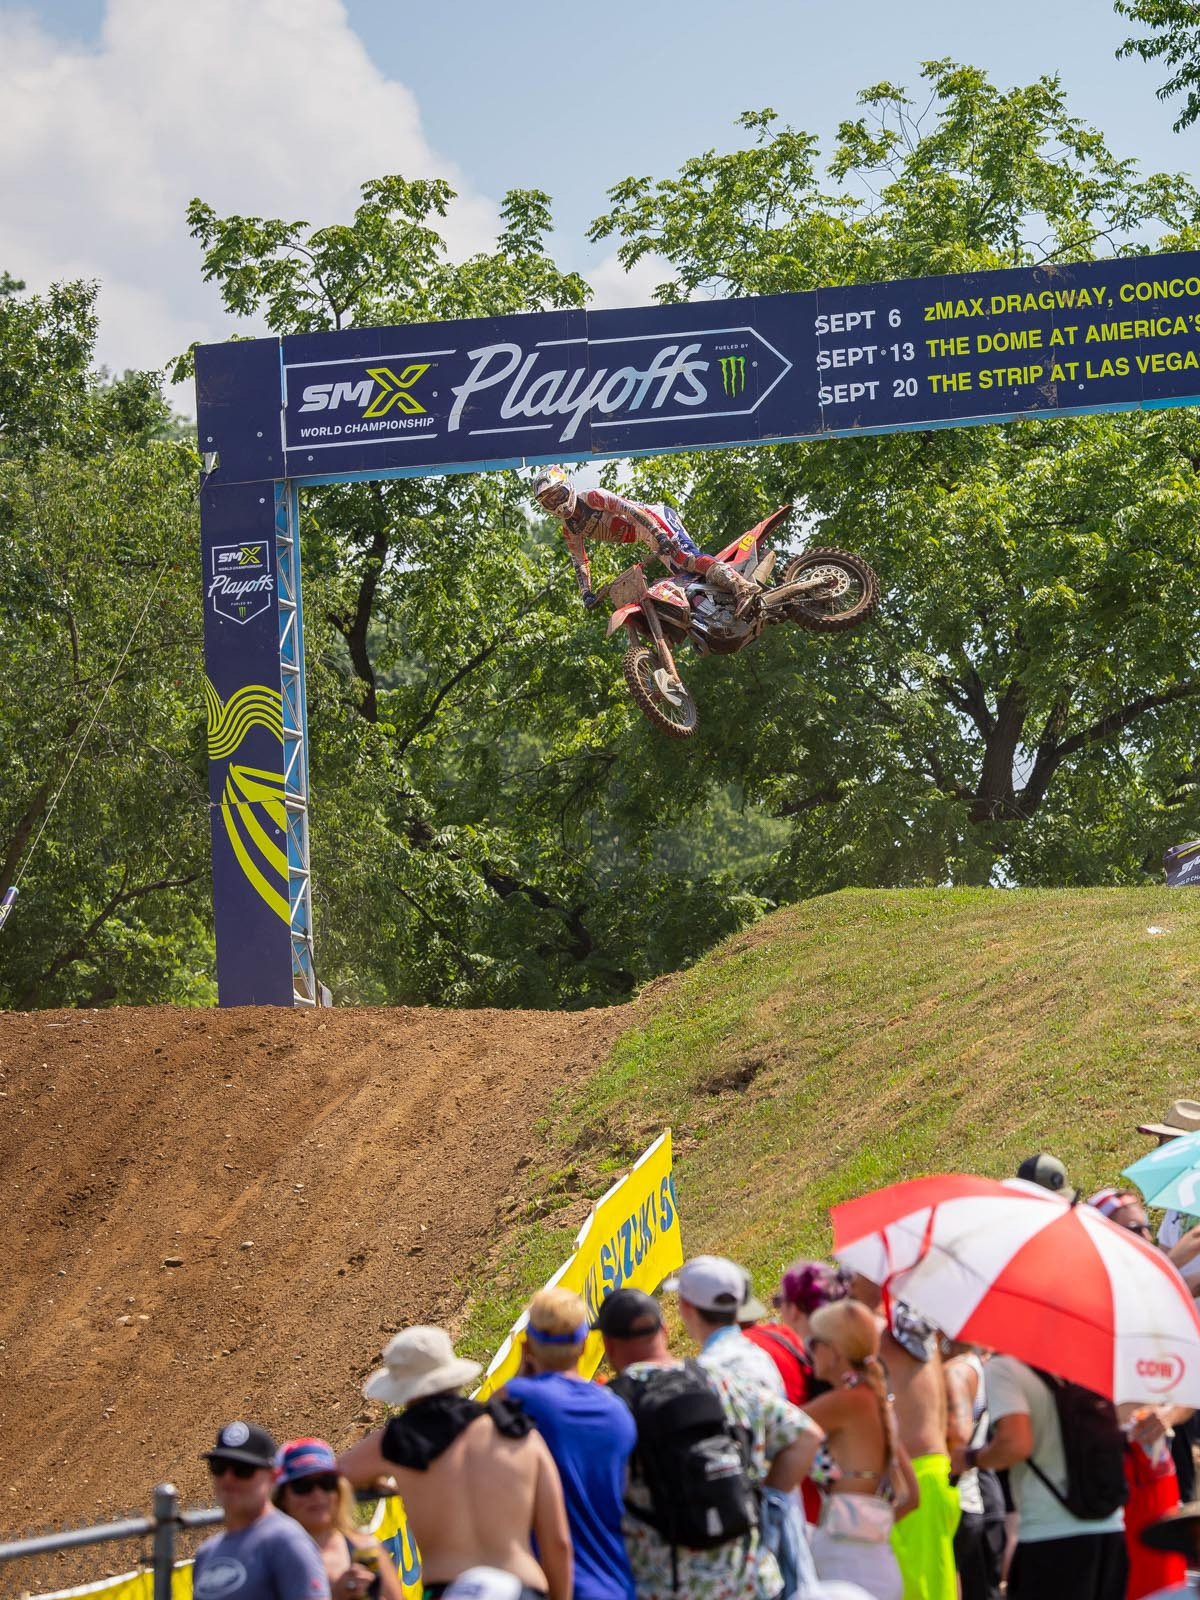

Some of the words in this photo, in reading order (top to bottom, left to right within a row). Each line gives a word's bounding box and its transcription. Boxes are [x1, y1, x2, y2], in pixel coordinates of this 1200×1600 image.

[814, 310, 876, 335] SEPT
[888, 308, 901, 328] 6
[924, 297, 984, 321] zMAX
[991, 286, 1113, 315] DRAGWAY,
[816, 345, 877, 371] SEPT
[890, 342, 915, 362] 13
[926, 336, 970, 358] THE
[977, 329, 1042, 354] DOME
[1049, 326, 1078, 346] AT
[298, 363, 431, 418] SMX
[447, 343, 709, 443] Playoffs
[818, 380, 880, 406] SEPT
[892, 377, 918, 399] 20
[927, 372, 972, 394] THE
[979, 365, 1043, 389] STRIP
[1049, 362, 1080, 382] AT
[1086, 356, 1130, 380] LAS
[300, 425, 342, 438] WORLD
[344, 417, 435, 434] CHAMPIONSHIP
[218, 546, 262, 565] SMX
[208, 574, 274, 600] Playoffs
[600, 1191, 657, 1298] SUZUKI
